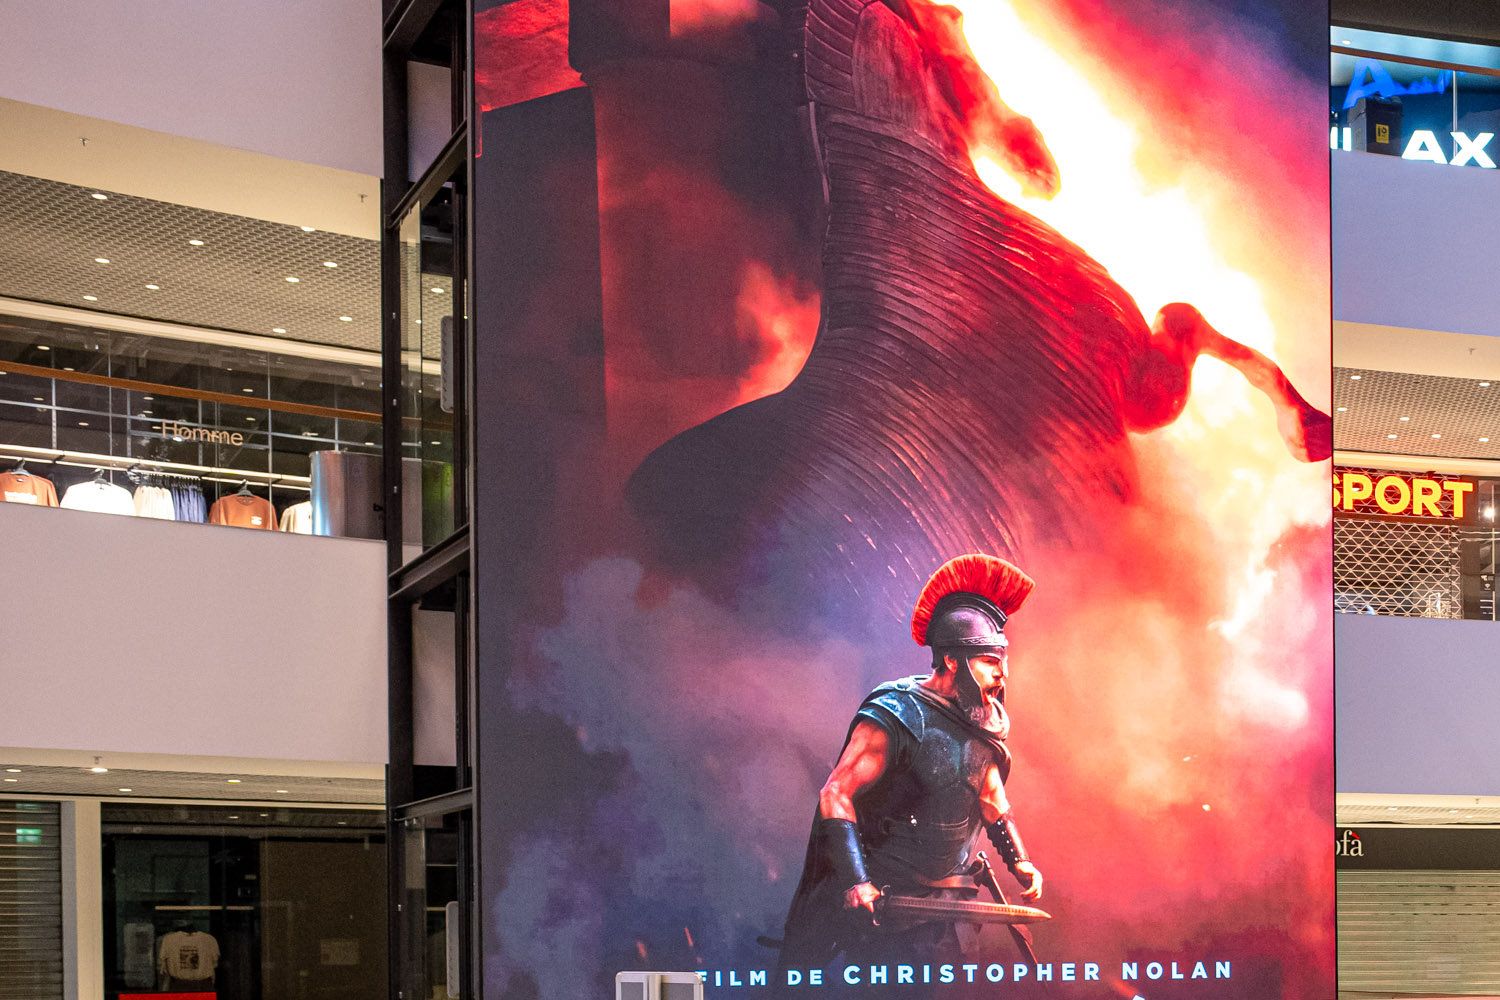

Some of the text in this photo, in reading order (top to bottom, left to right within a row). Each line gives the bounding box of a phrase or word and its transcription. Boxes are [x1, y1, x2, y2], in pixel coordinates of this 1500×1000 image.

[162, 419, 243, 446] Homme
[787, 969, 823, 986] DE
[843, 963, 1100, 985] CHRISTOPHER
[1122, 961, 1231, 980] NOLAN
